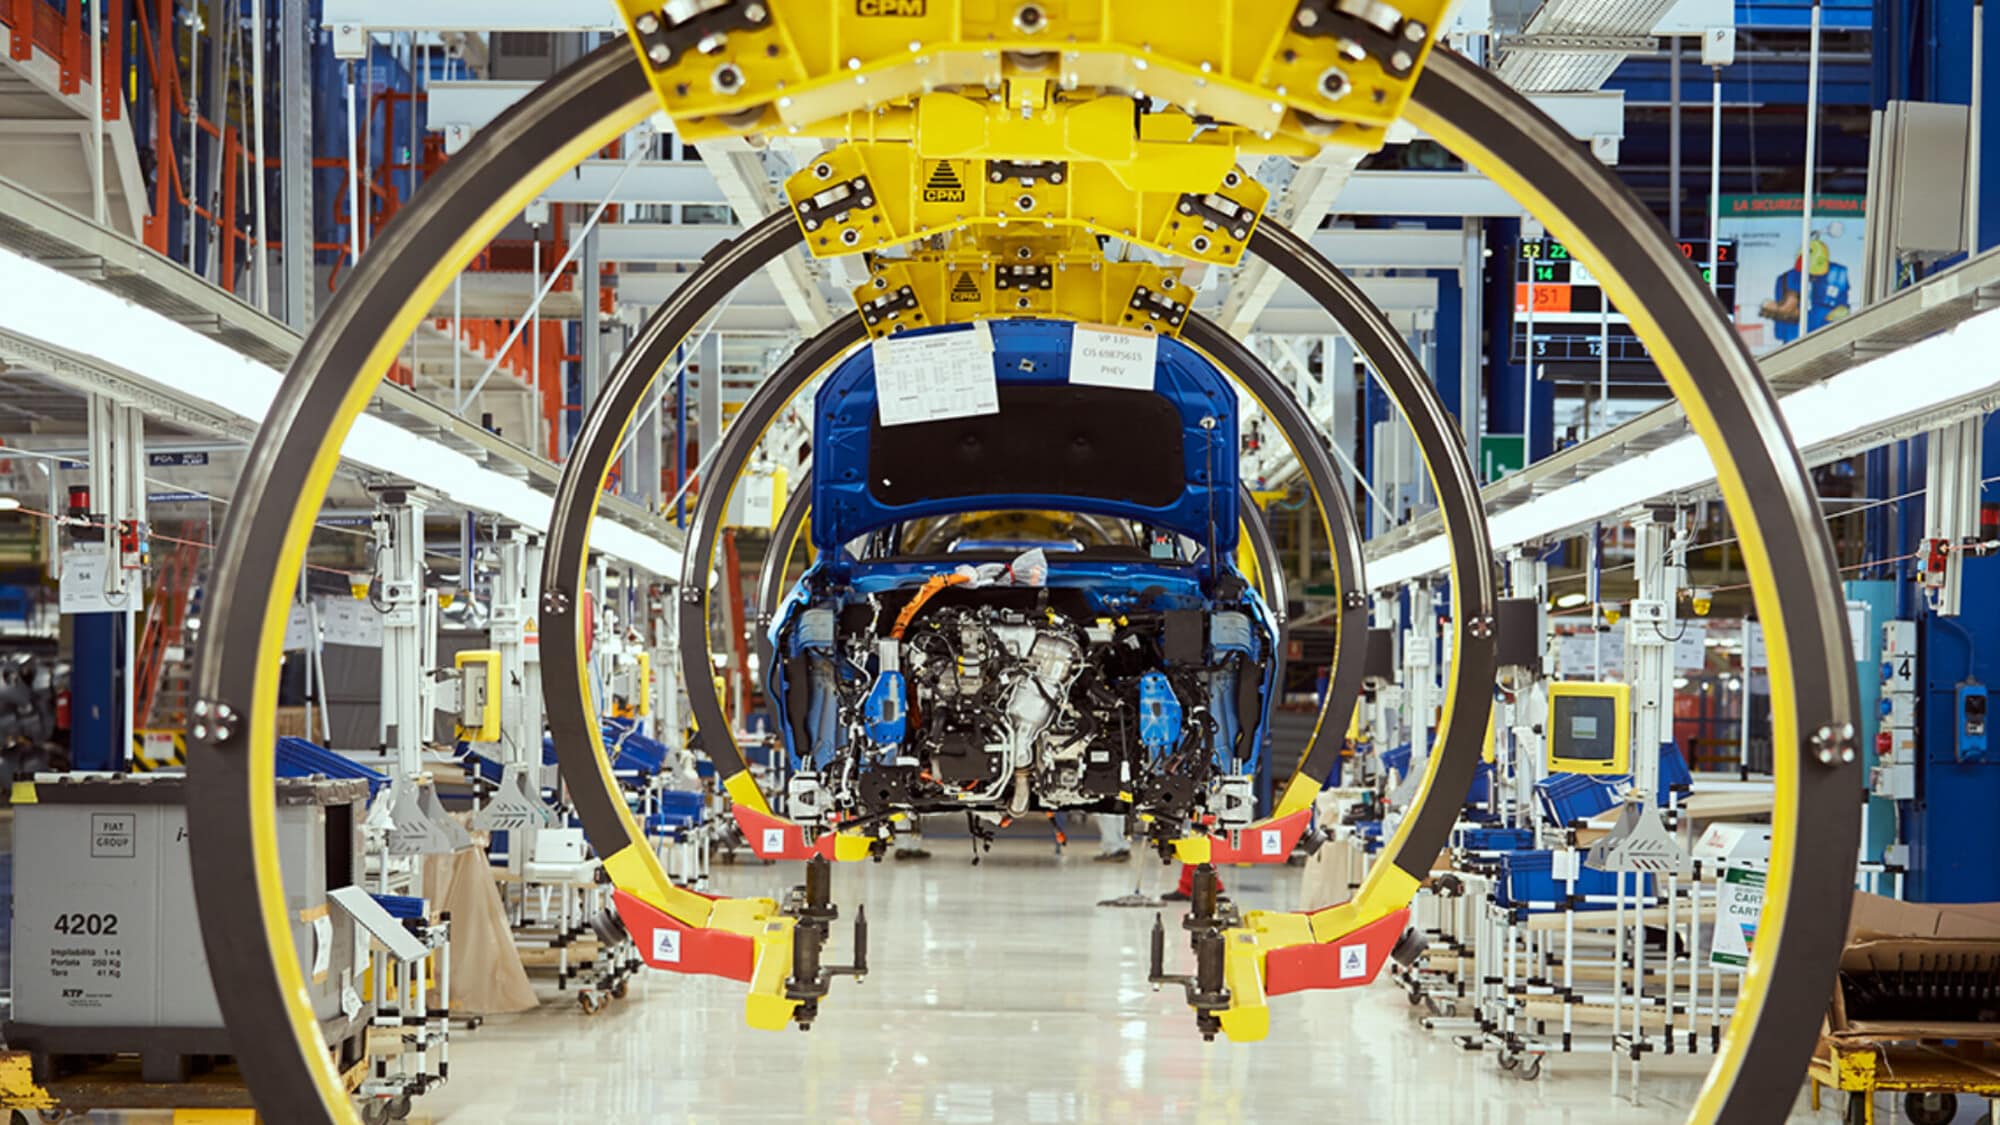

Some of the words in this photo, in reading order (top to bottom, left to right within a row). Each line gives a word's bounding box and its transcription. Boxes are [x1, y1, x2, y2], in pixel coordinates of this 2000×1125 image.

[859, 0, 925, 17] CPM
[924, 189, 964, 202] CPM
[1733, 199, 1749, 212] LA
[1523, 244, 1540, 258] 52
[1550, 244, 1567, 259] 22
[1536, 267, 1553, 281] 14
[1537, 342, 1546, 356] 3
[1898, 658, 1912, 681] 4
[103, 822, 124, 831] FIAT
[96, 838, 129, 848] GROUP
[54, 913, 118, 935] 4202
[109, 959, 121, 969] Kg
[109, 969, 121, 979] Kg
